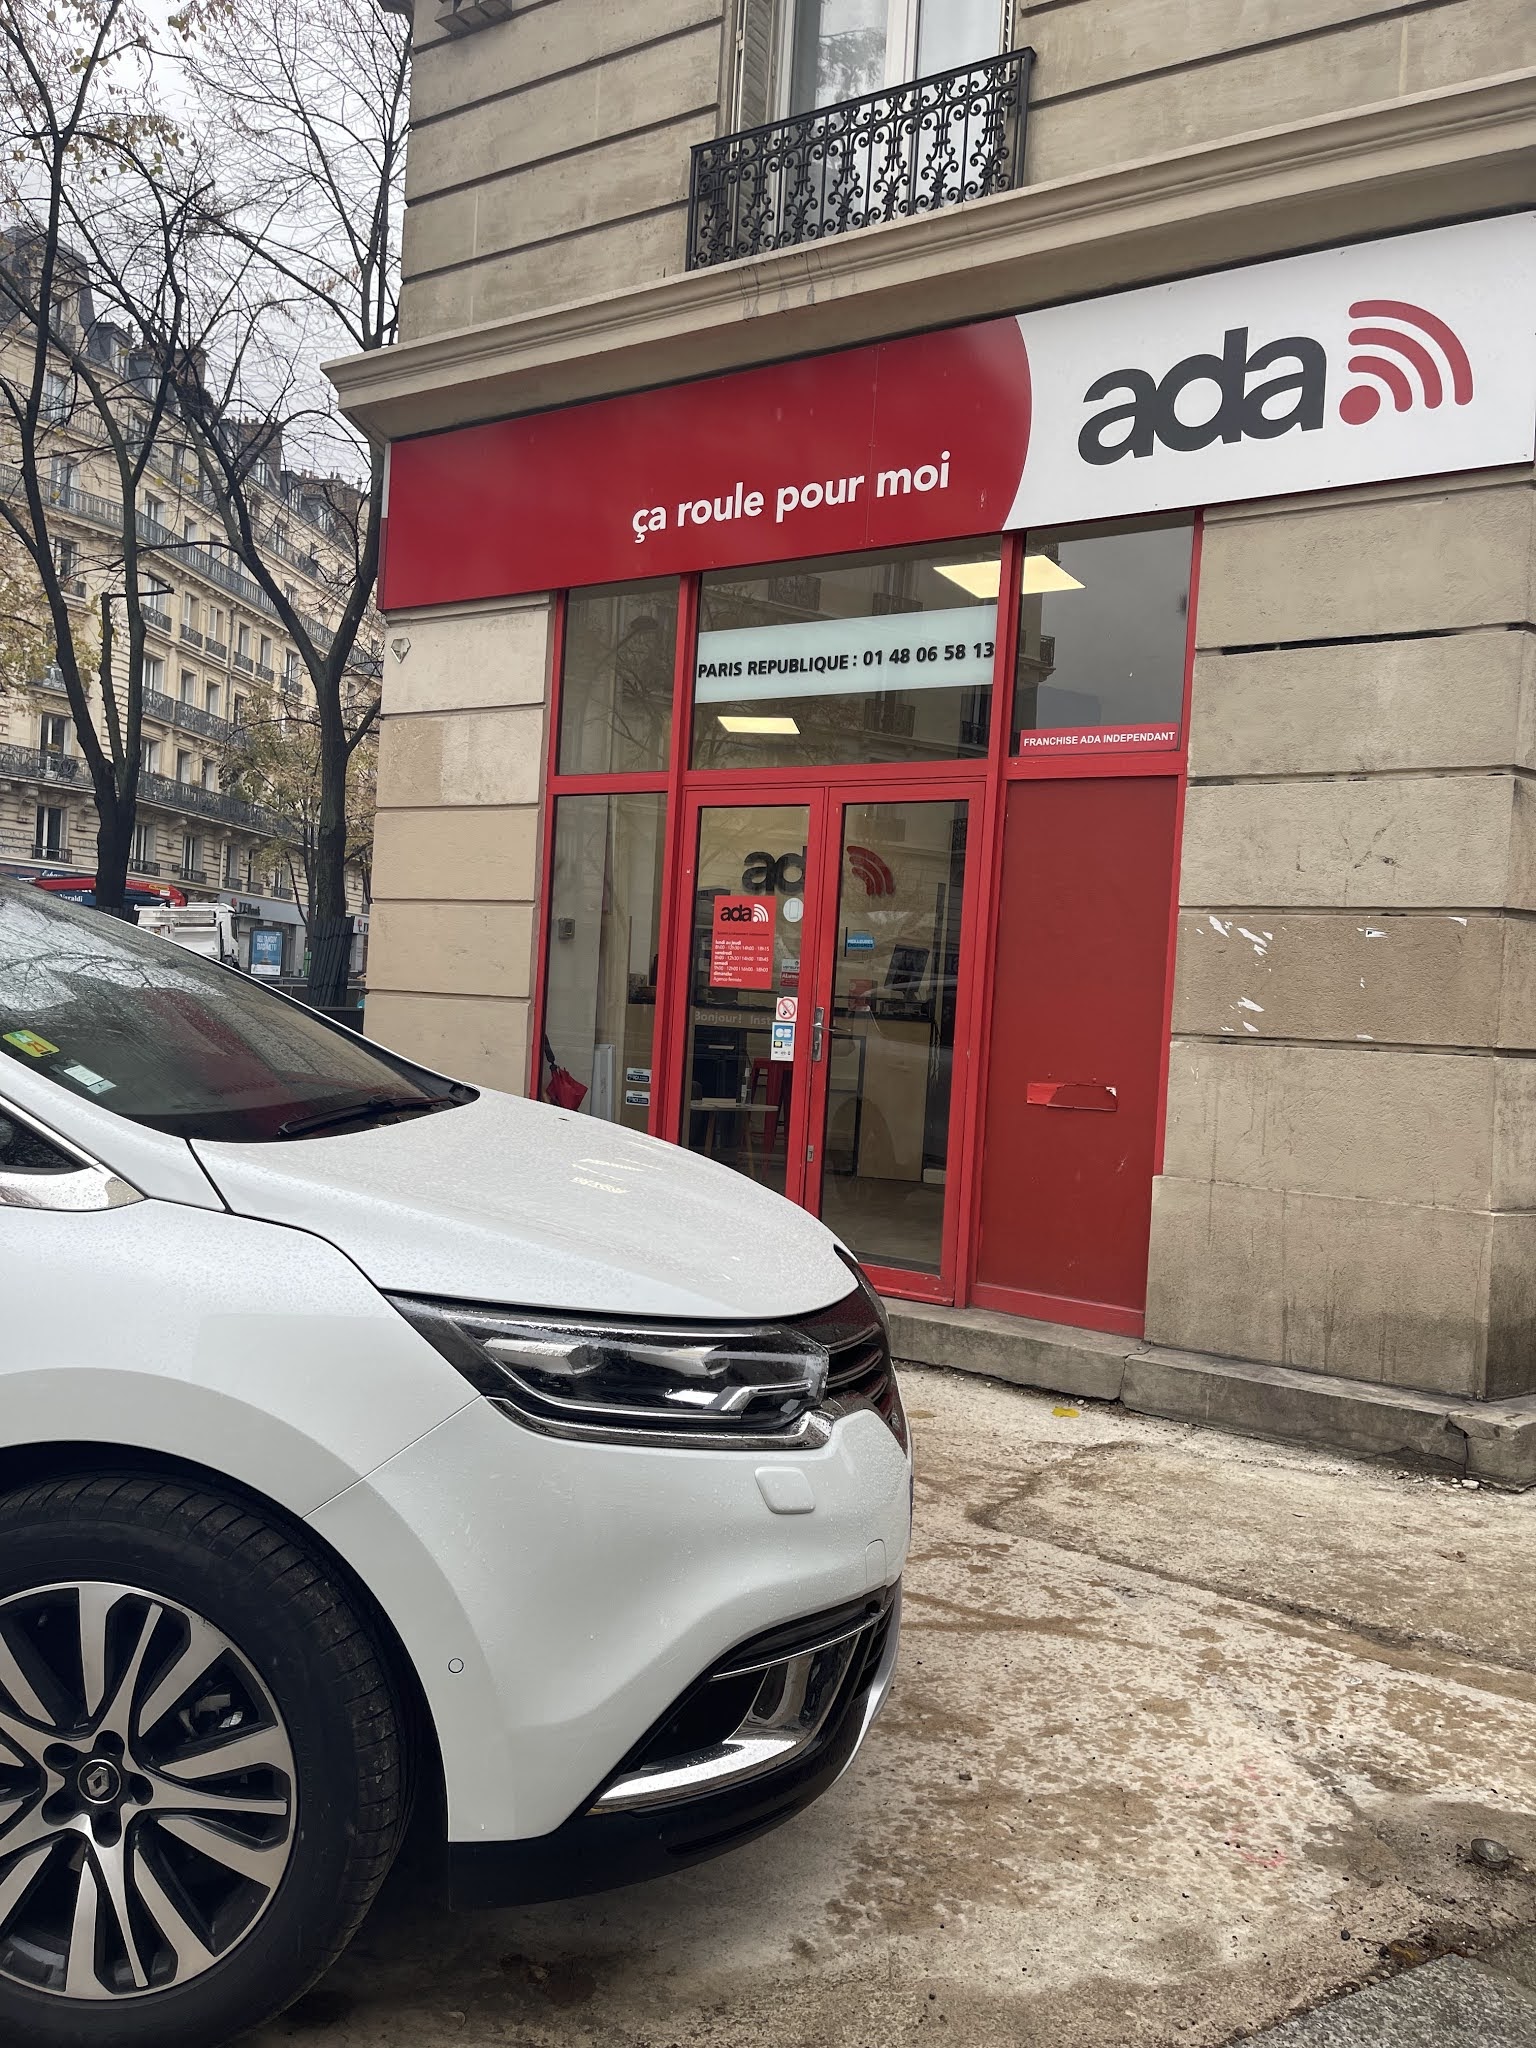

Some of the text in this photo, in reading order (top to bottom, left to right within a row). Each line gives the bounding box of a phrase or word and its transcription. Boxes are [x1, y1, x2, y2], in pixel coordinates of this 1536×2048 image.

[1078, 326, 1327, 466] ada
[632, 450, 951, 544] ça roule pour moi
[698, 661, 742, 678] PARIS
[747, 654, 849, 676] REPUBLIQUE
[863, 650, 883, 666] 01
[889, 648, 910, 664] 48
[916, 646, 938, 663] 06
[944, 644, 966, 661] 58
[973, 641, 995, 659] 13
[1023, 731, 1175, 747] FRANCHISE ADA INDEPENDANT
[742, 846, 807, 895] ad
[720, 904, 752, 921] ada
[750, 1015, 775, 1026] Inst
